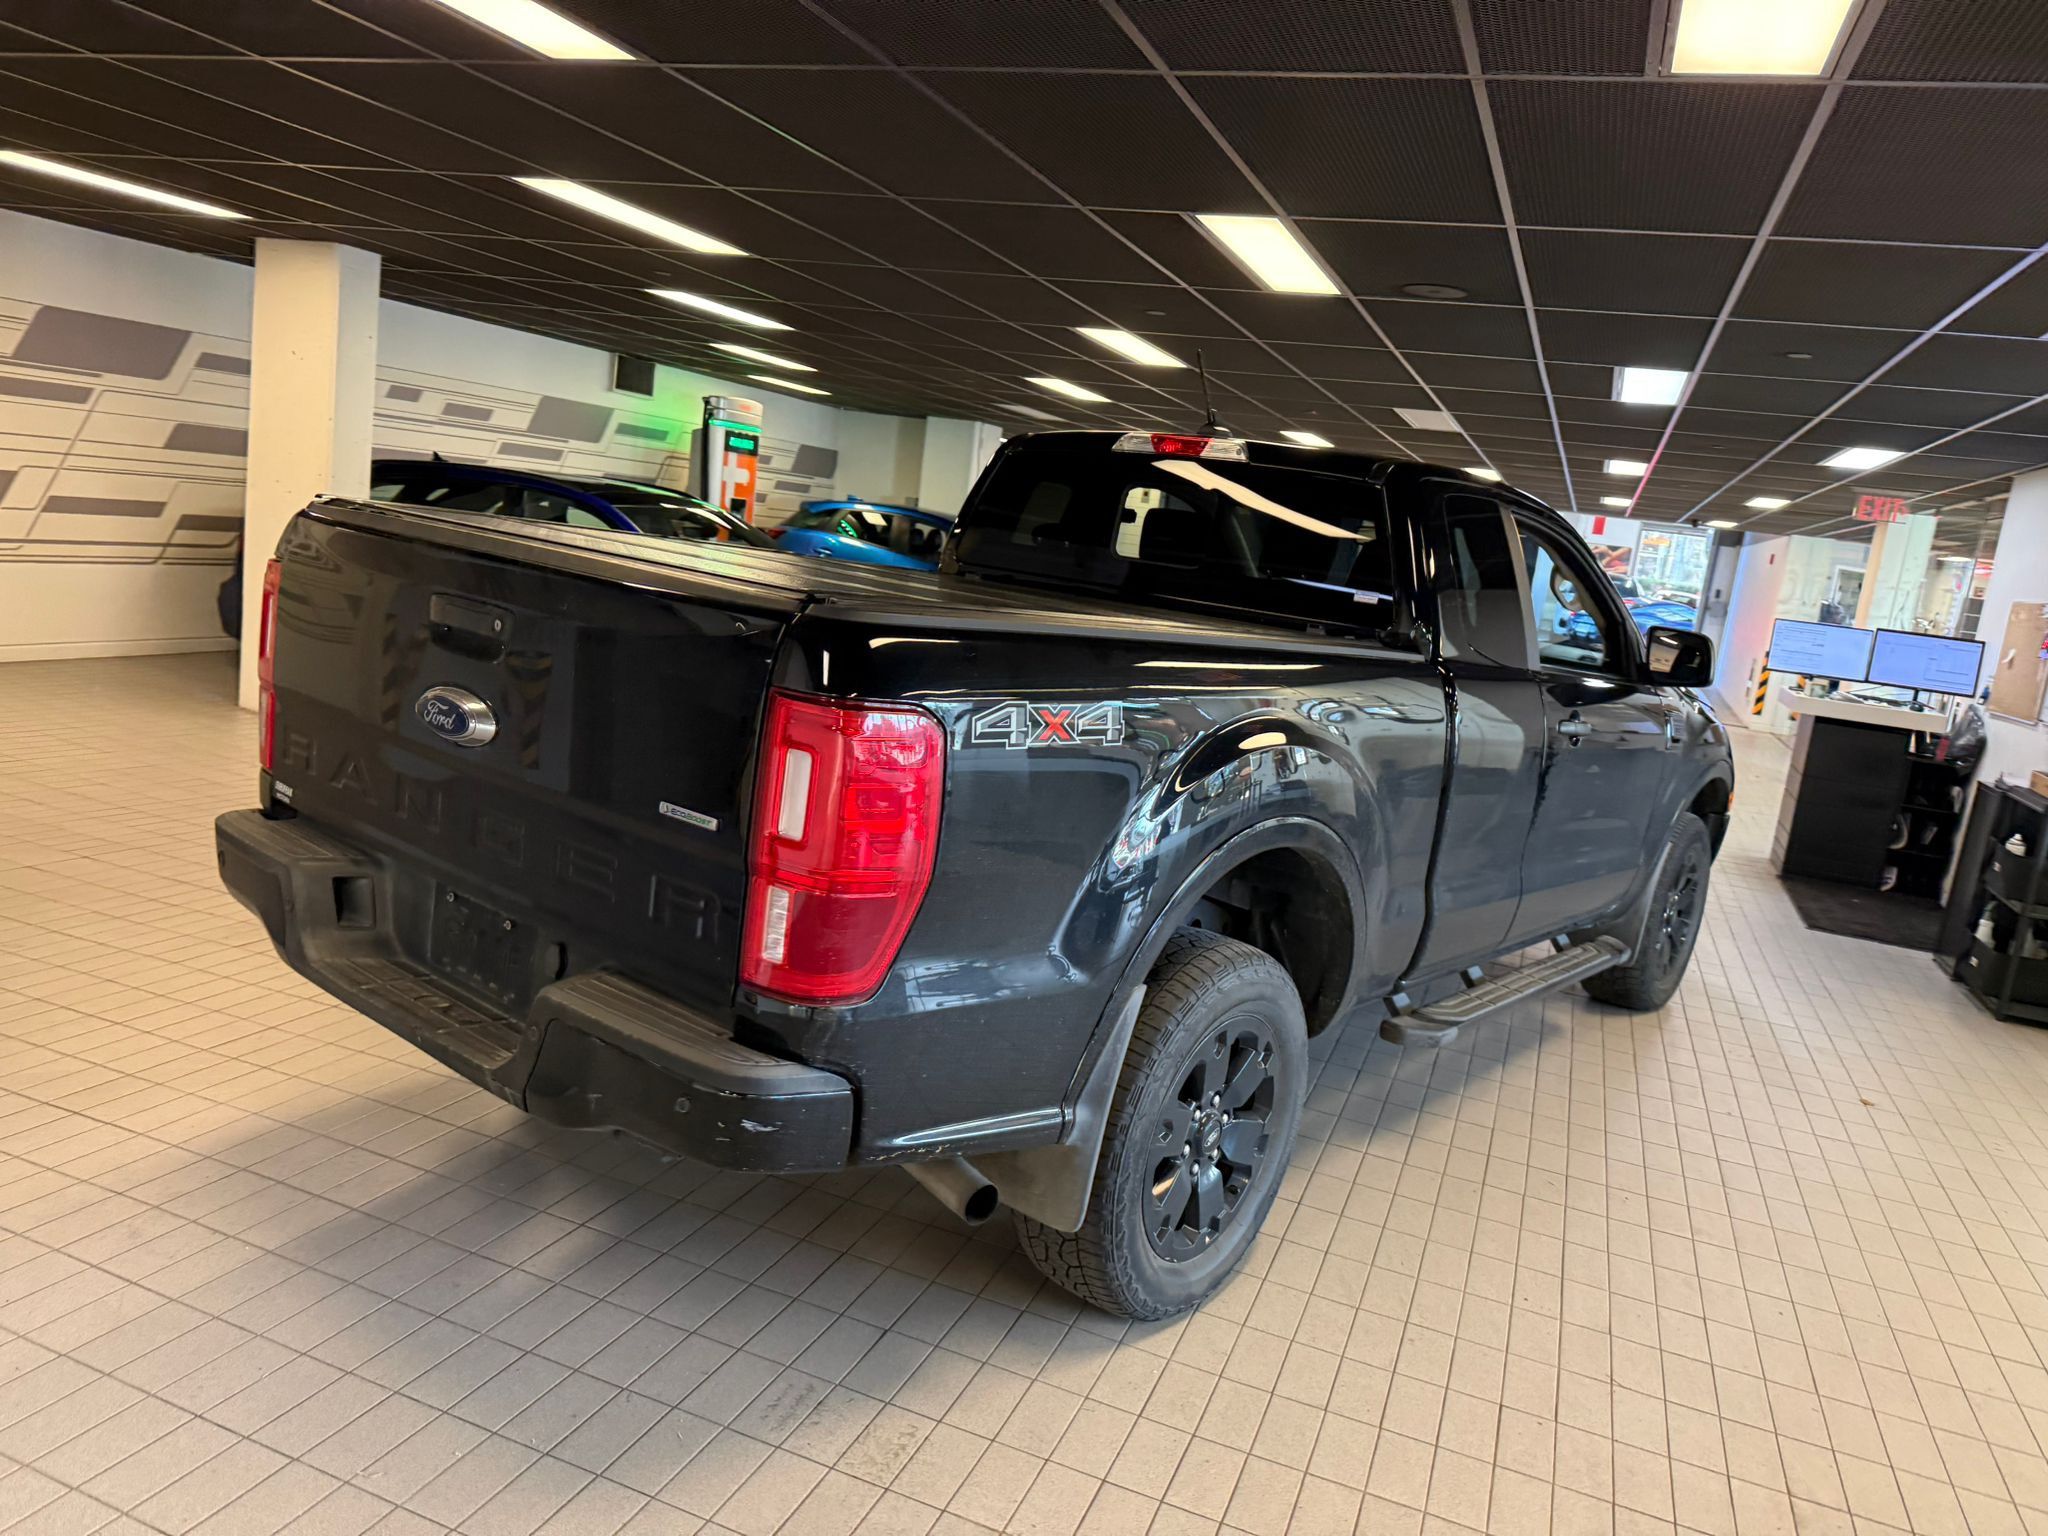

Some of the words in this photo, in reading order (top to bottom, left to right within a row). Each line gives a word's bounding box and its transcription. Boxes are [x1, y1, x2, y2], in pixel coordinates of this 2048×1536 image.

[1857, 495, 1905, 523] EXIT
[423, 699, 456, 730] Ford
[284, 729, 721, 943] RANGER
